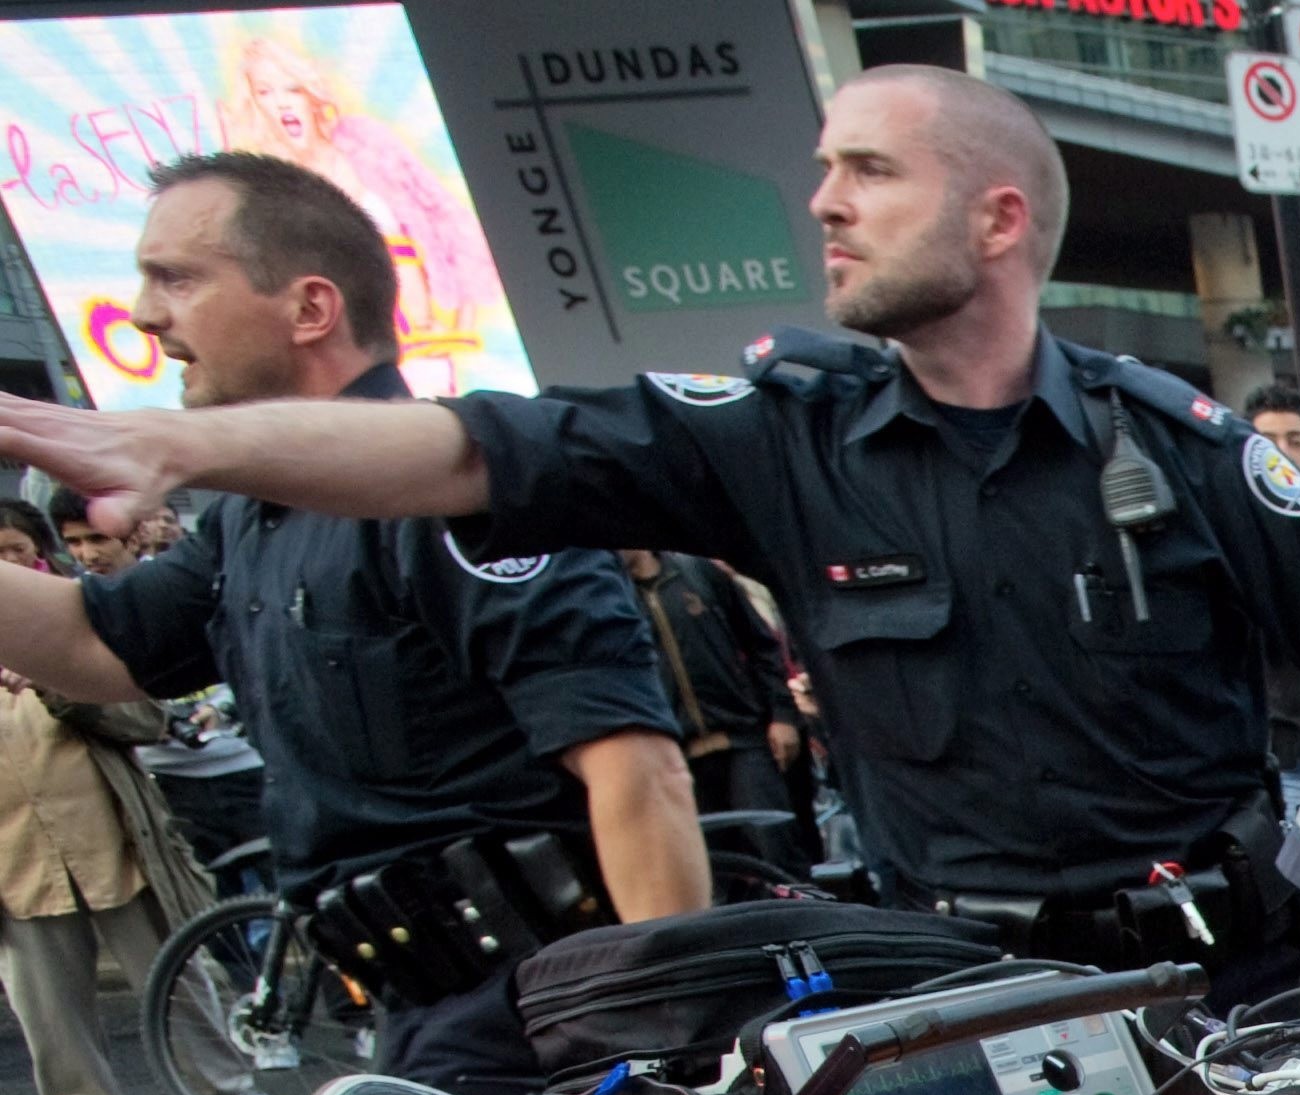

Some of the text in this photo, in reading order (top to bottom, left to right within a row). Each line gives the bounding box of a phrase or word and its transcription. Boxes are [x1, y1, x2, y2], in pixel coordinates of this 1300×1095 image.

[541, 43, 740, 85] DUNDAS
[506, 131, 590, 311] YONGE
[622, 257, 796, 304] SQUARE
